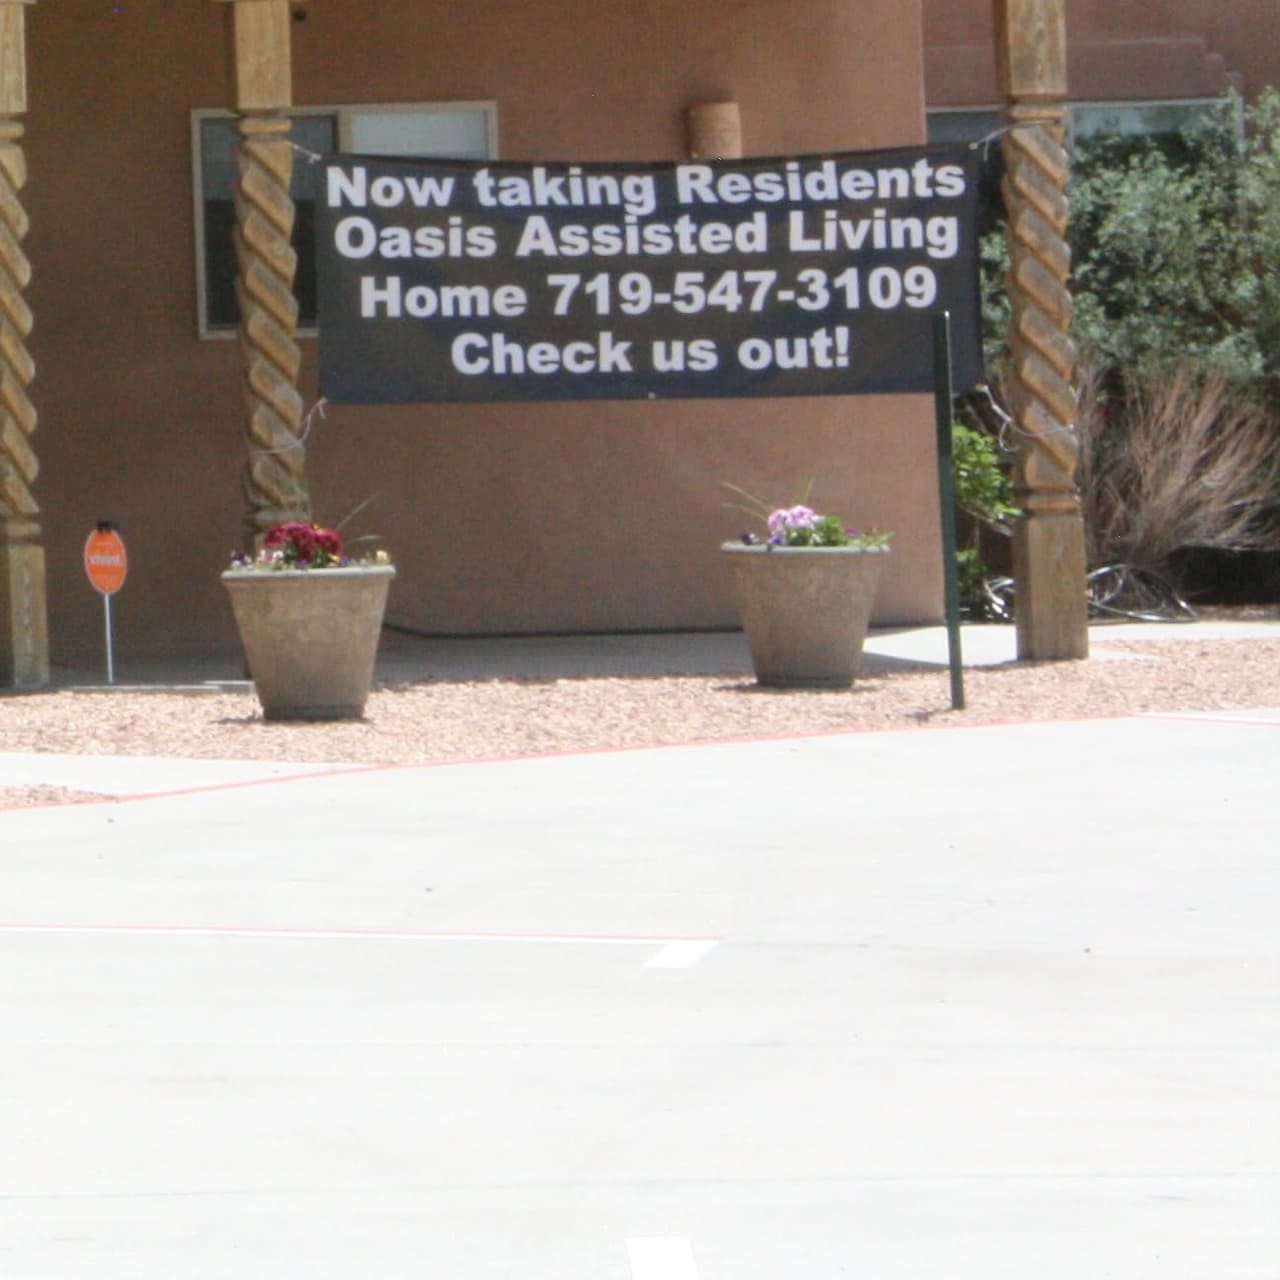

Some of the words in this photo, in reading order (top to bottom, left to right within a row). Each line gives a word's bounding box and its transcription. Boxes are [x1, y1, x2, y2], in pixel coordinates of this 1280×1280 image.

[326, 166, 455, 208] Now
[472, 166, 657, 214] taking
[676, 160, 966, 204] Residents
[334, 216, 497, 259] Oasis
[515, 209, 768, 257] Assisted
[789, 207, 959, 259] Living
[360, 276, 528, 318] Home
[547, 265, 937, 316] 719-547-3109
[451, 331, 633, 375] Check
[652, 339, 718, 372] us
[737, 325, 849, 370] out!
